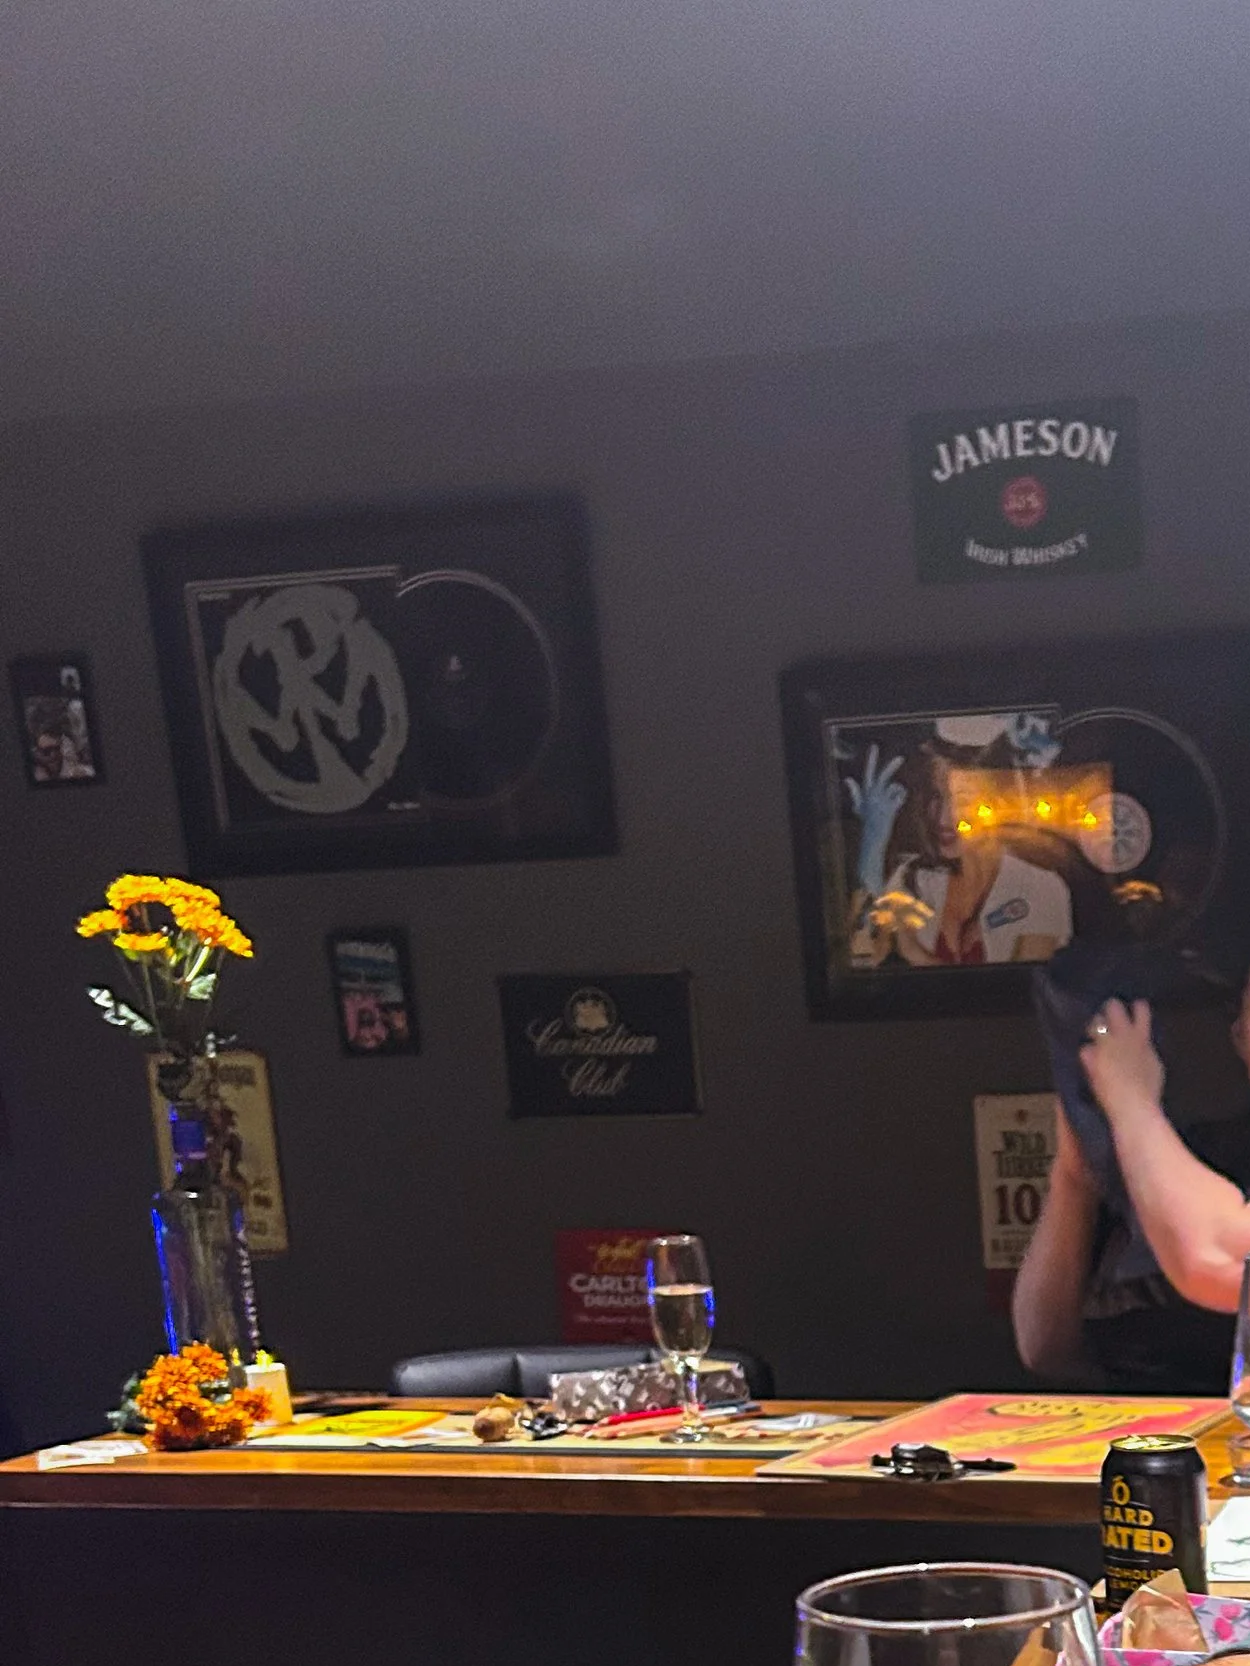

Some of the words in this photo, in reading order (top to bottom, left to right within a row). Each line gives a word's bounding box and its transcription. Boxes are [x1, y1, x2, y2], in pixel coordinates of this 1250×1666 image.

[931, 418, 1118, 483] JAMESON
[995, 1183, 1042, 1226] 10
[568, 1273, 648, 1294] CARLT
[1103, 1525, 1174, 1554] ATED
